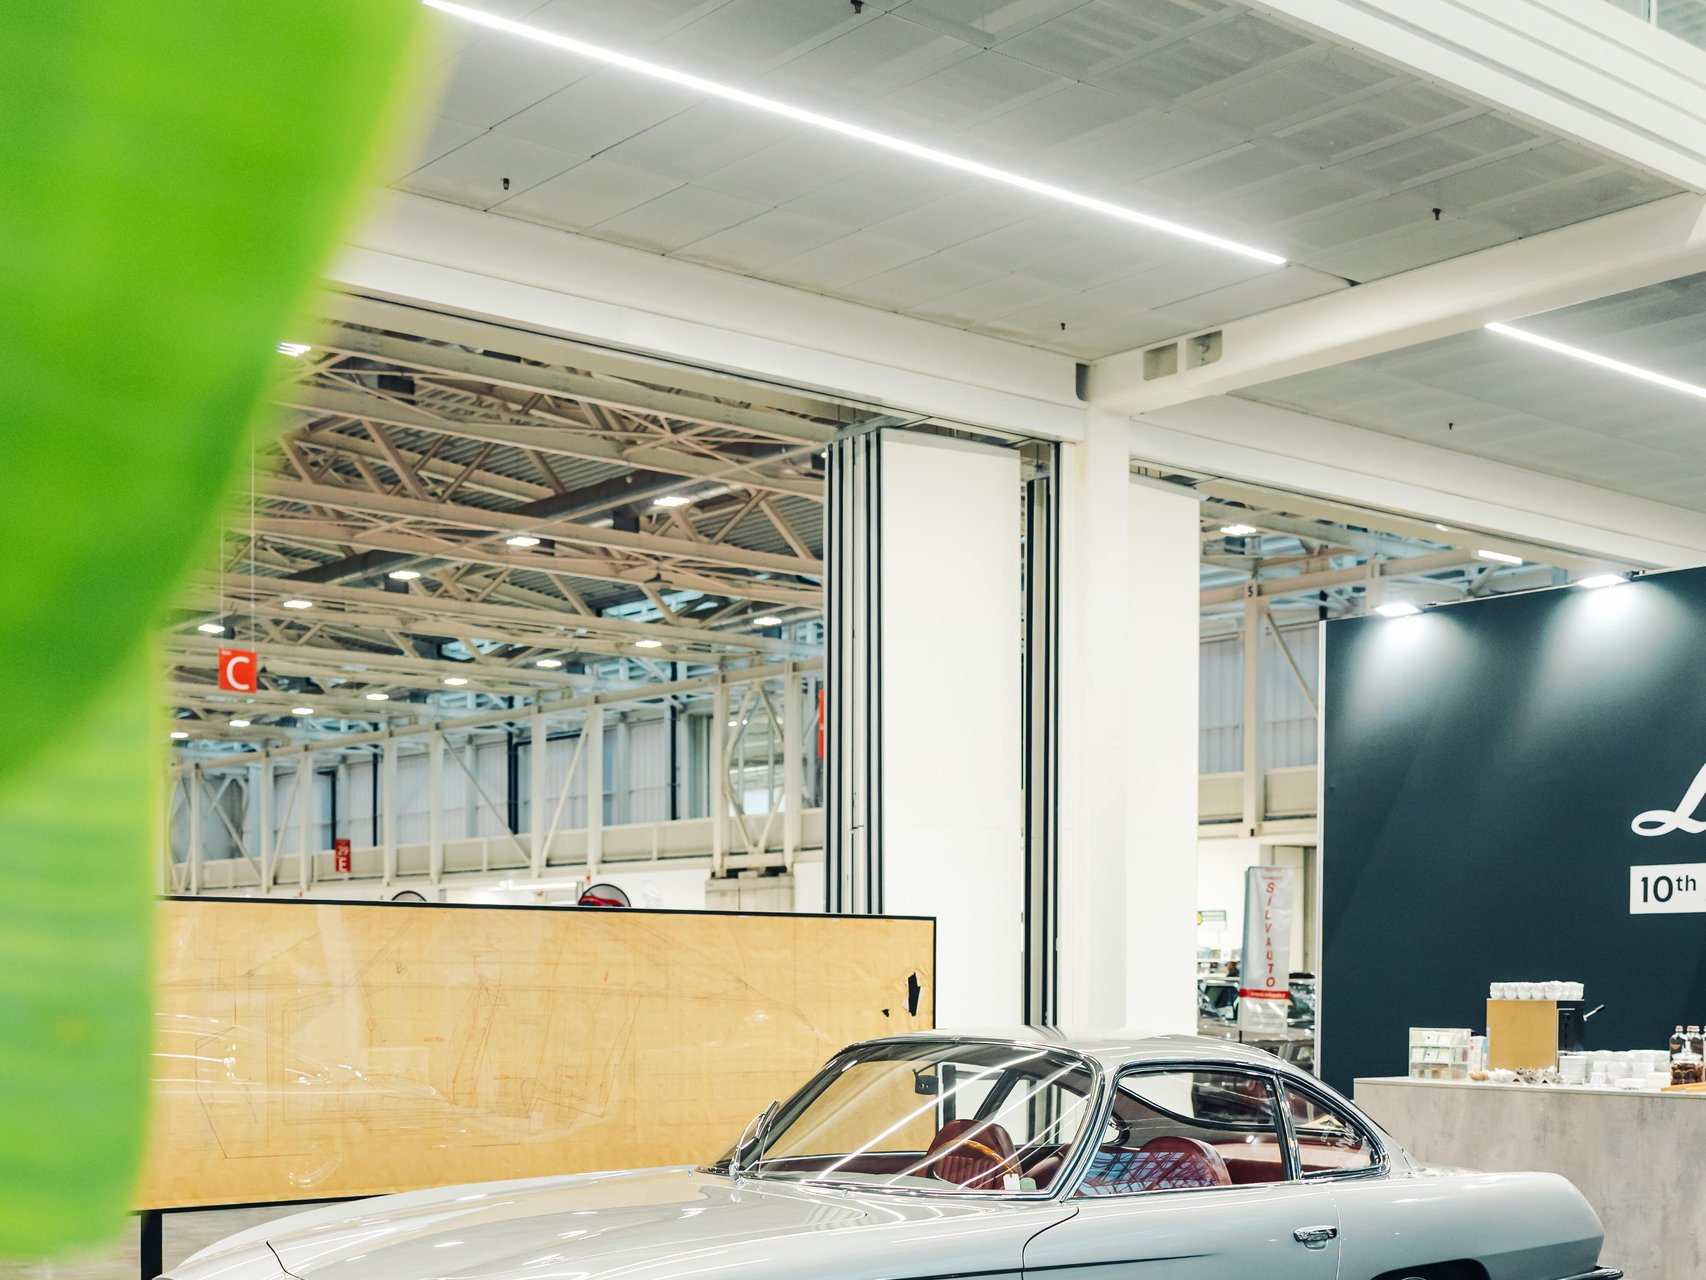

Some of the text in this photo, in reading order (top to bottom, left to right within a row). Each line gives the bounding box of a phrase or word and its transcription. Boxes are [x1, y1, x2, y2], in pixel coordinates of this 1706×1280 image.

[226, 656, 250, 690] C
[1641, 875, 1697, 903] 10th
[1265, 882, 1276, 988] SILVAUTO
